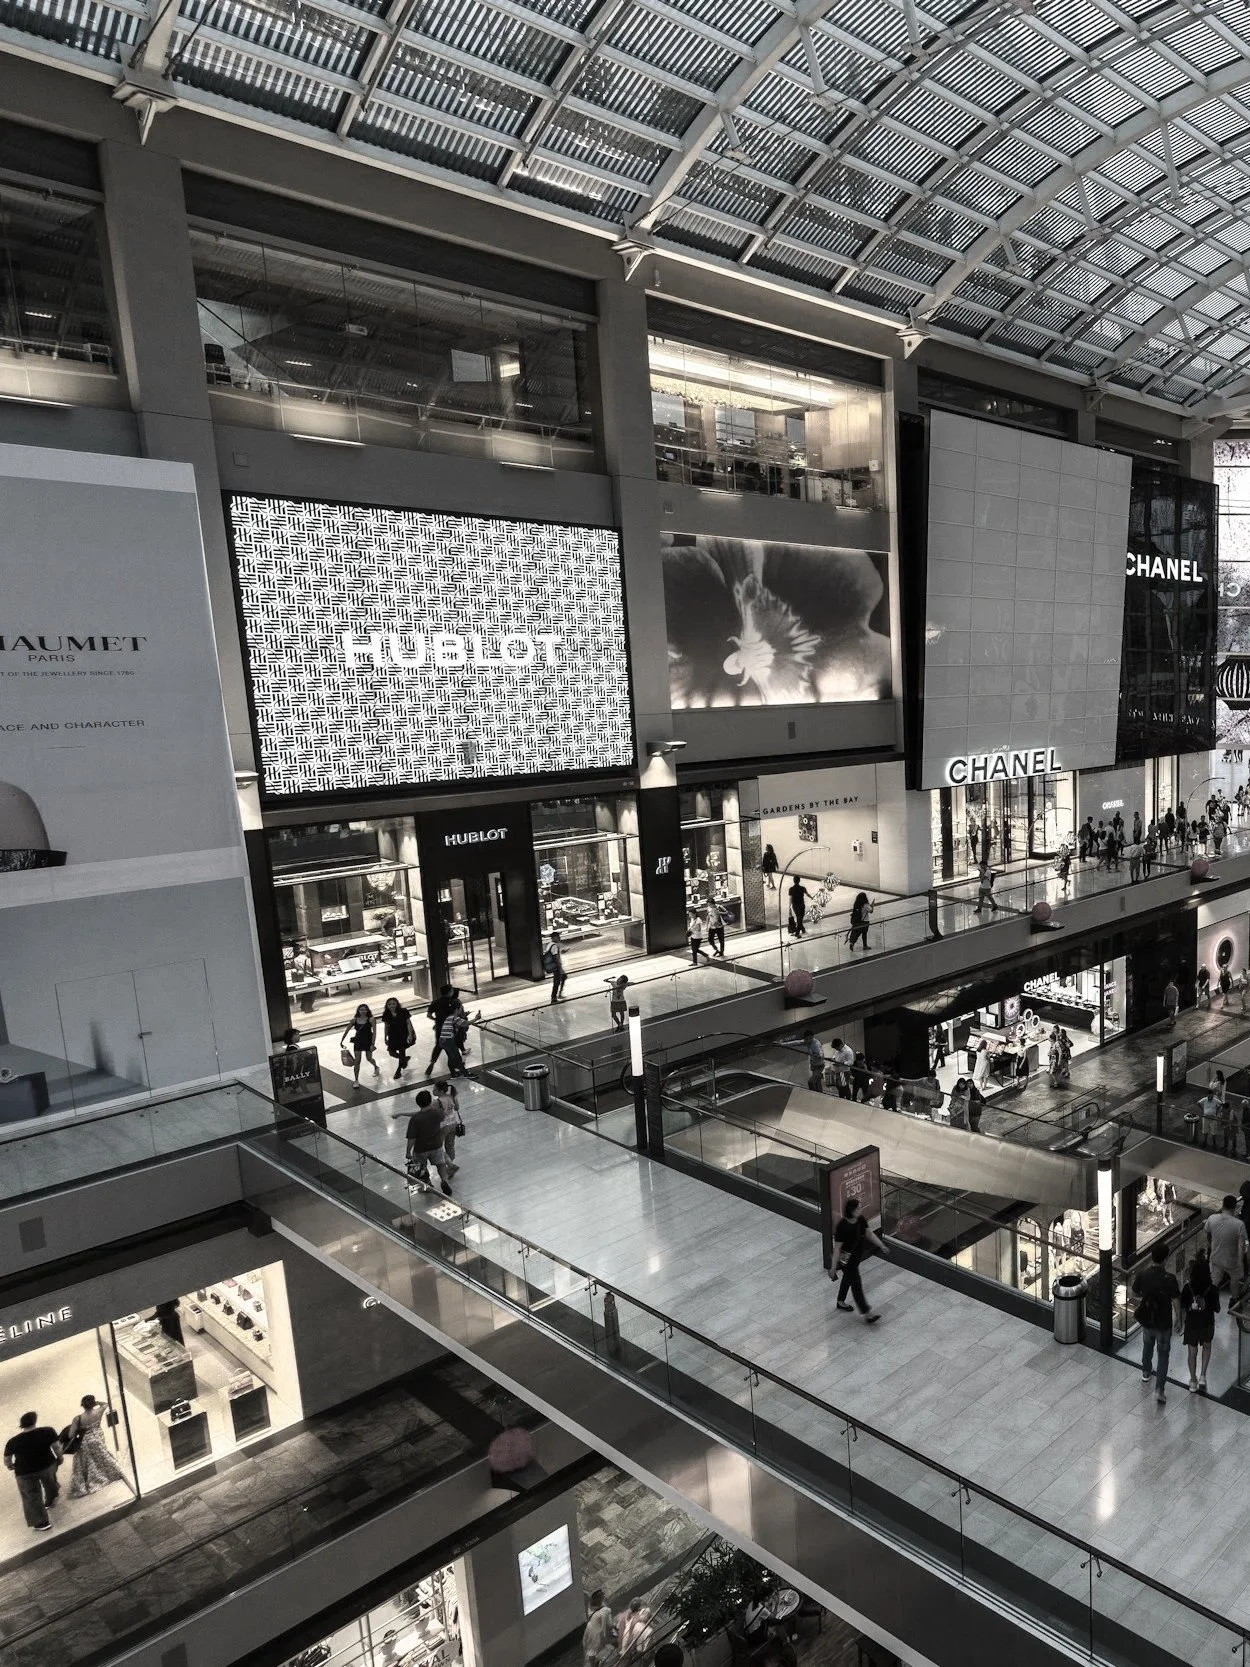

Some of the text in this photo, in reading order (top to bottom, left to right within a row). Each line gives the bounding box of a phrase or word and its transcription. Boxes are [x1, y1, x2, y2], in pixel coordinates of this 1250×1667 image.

[1126, 552, 1203, 583] CHANEL
[28, 654, 76, 663] PARIS
[342, 632, 562, 668] HUBLOT
[30, 723, 59, 731] AND
[64, 719, 145, 730] CHARACTER
[949, 749, 1062, 784] CHANEL
[763, 796, 859, 815] GARDENS BY THE BAY
[444, 827, 509, 847] HUBLOT
[1023, 971, 1060, 992] CHANEL
[284, 1071, 311, 1083] BALLY
